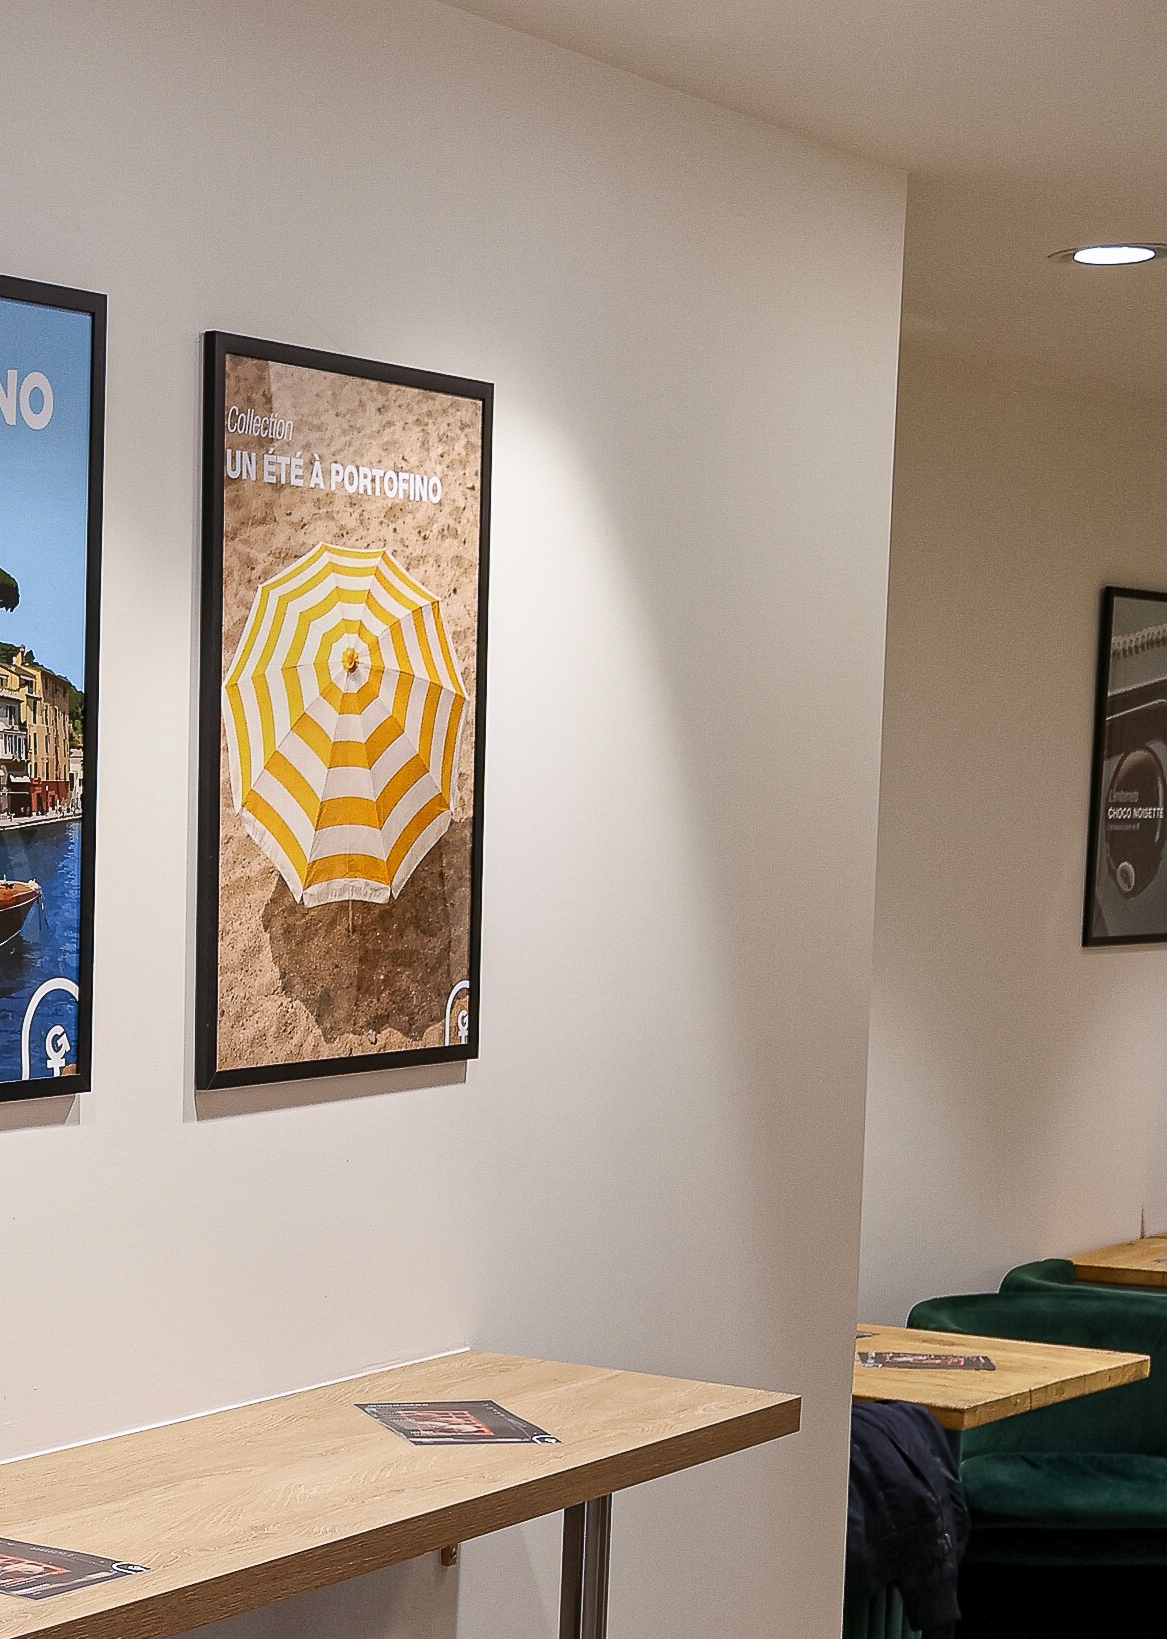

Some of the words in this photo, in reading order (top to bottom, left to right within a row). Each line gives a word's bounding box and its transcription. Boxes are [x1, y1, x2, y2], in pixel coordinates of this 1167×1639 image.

[227, 405, 294, 441] Collection
[225, 448, 257, 481] UN
[263, 447, 304, 488] ÉTÉ
[309, 452, 325, 490] À
[330, 462, 443, 505] PORTOFINO
